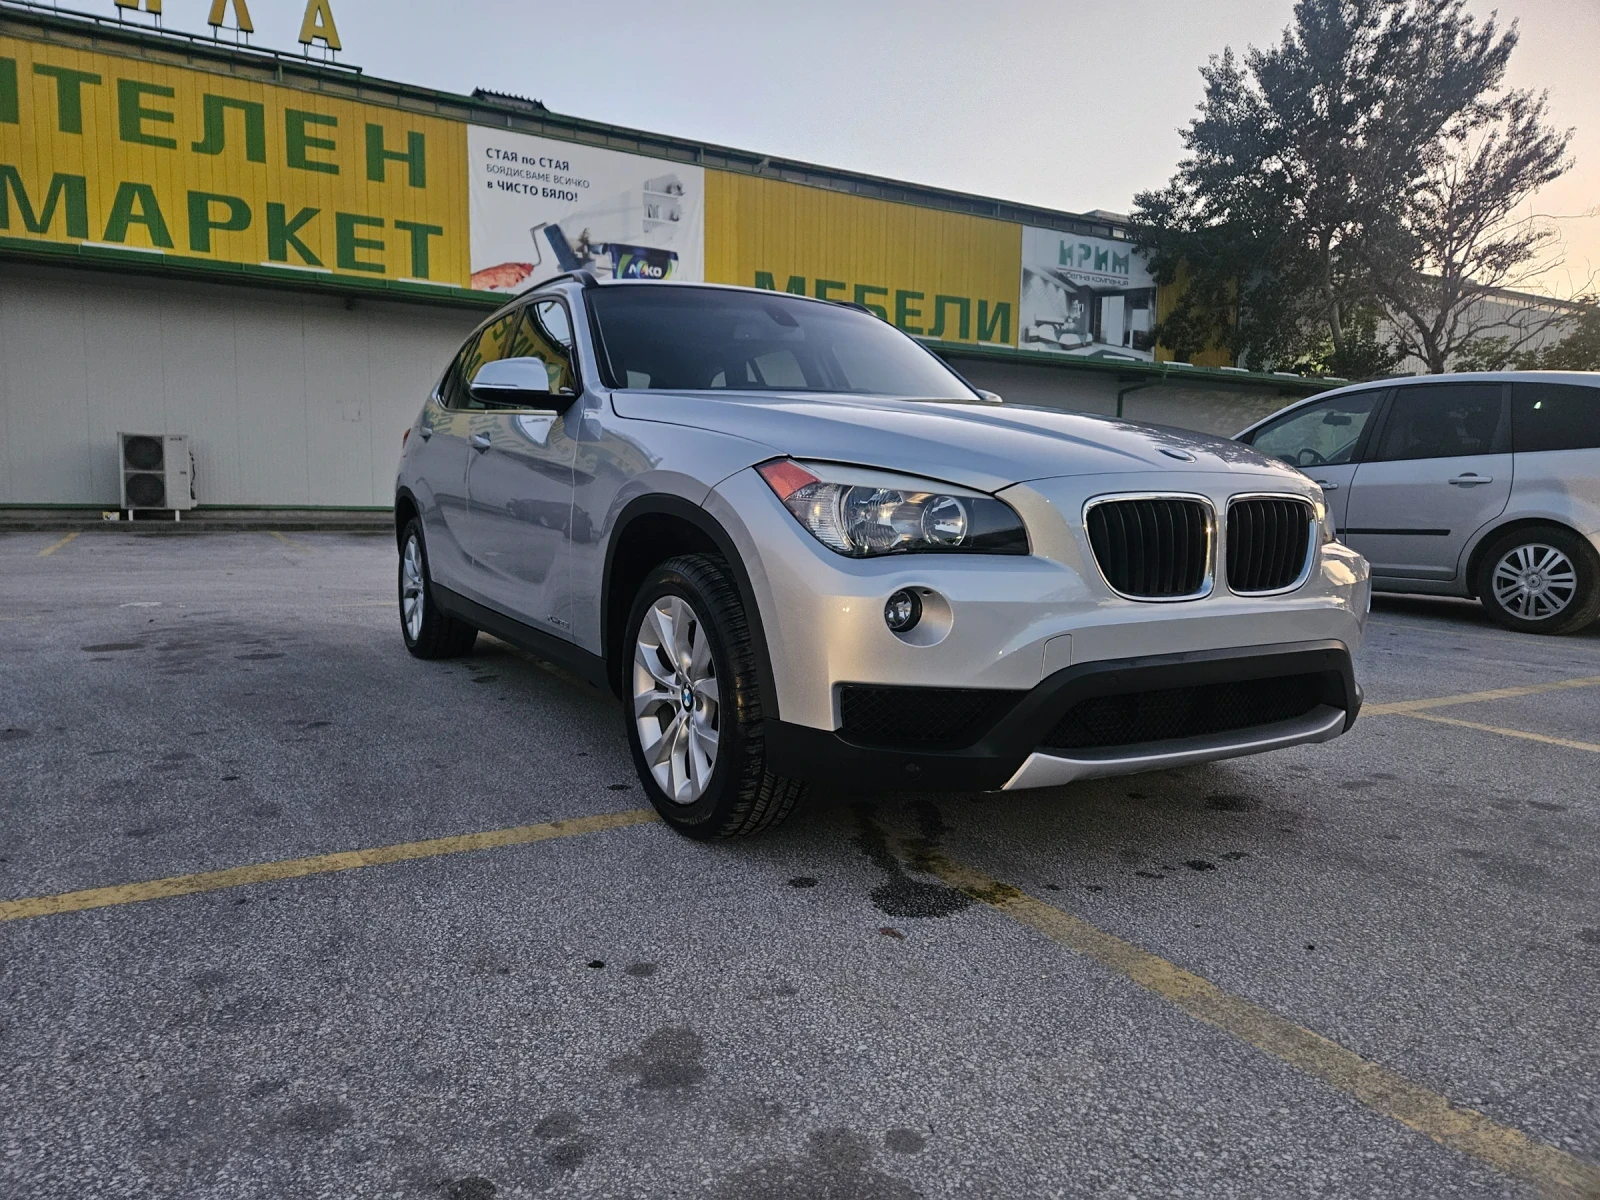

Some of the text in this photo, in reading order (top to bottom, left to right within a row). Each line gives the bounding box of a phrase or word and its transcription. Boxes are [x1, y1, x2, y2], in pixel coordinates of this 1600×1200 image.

[486, 148, 569, 171] СТАЯ по СТАЯ
[486, 163, 590, 189] БОЯДИСВАМЕ ВСИЧКО
[497, 180, 538, 196] ЧИСТО
[542, 187, 578, 202] БЯЛО!
[0, 164, 443, 279] МАРКЕТ
[1058, 240, 1129, 274] ИРИМ
